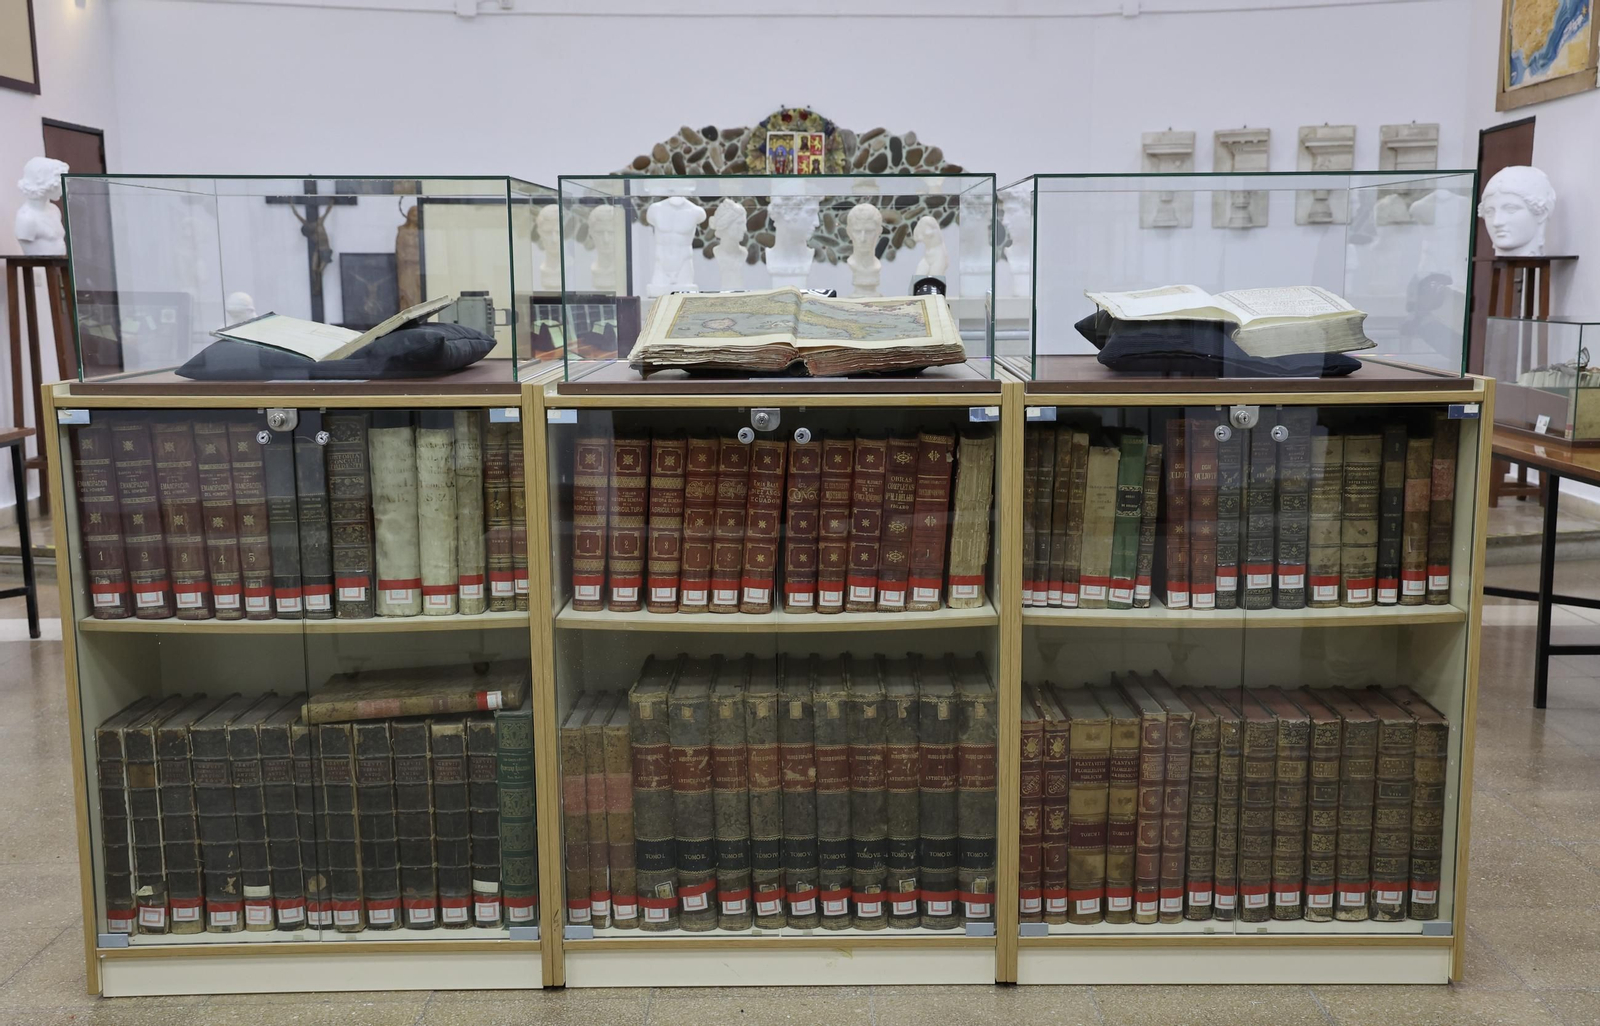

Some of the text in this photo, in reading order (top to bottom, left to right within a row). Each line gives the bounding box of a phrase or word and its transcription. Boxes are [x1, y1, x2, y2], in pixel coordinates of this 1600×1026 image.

[99, 551, 104, 561] 1
[142, 552, 149, 562] 2
[181, 552, 188, 562] 3
[219, 554, 225, 564] 4
[249, 552, 255, 562] 5
